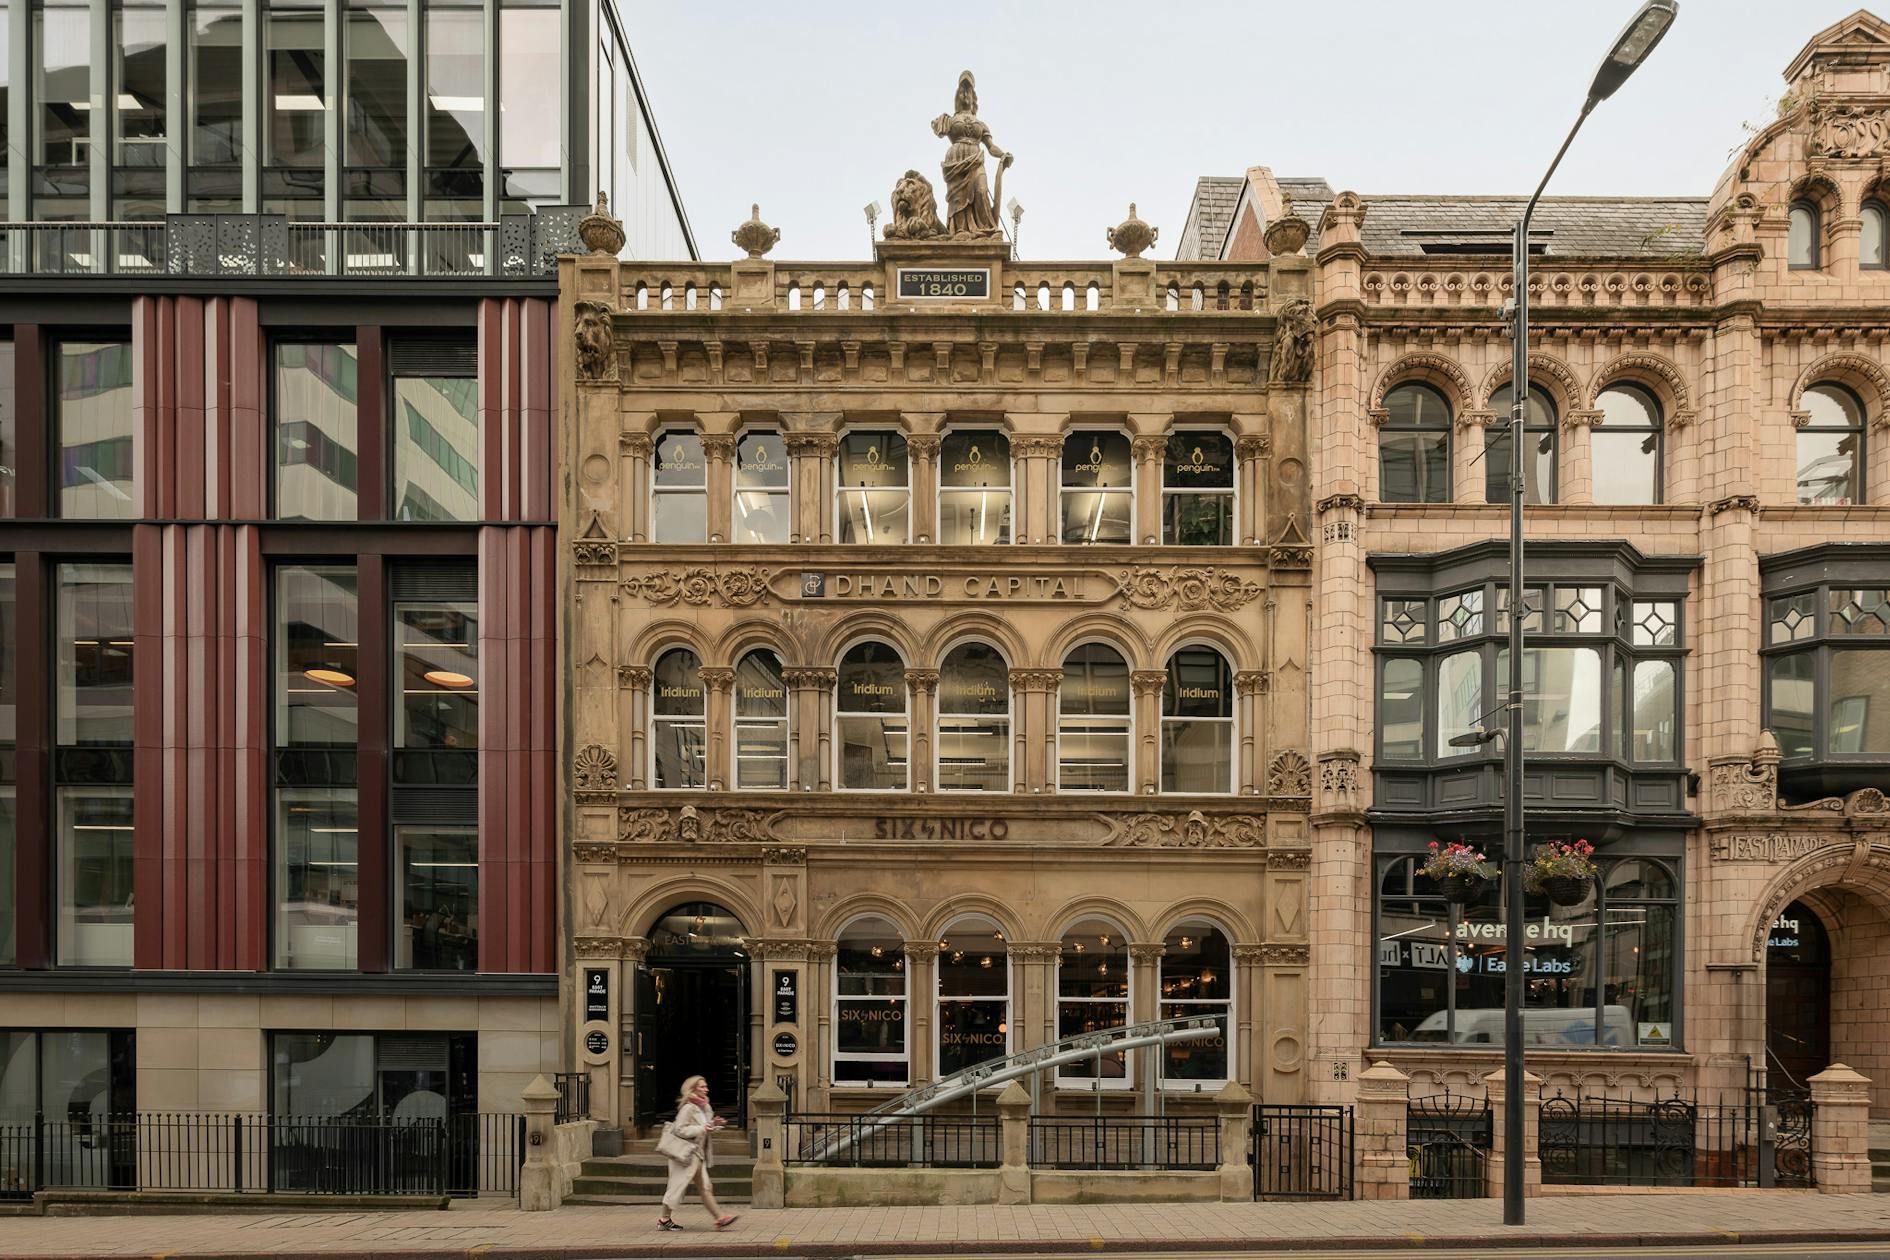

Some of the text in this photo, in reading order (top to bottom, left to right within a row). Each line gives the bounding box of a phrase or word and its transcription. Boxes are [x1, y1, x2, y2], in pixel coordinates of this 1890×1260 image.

[904, 274, 983, 282] ESTABLISHED
[920, 283, 967, 296] 1840
[660, 462, 695, 471] penguin
[742, 462, 777, 472] penguin
[852, 463, 889, 472] penguin
[1177, 463, 1214, 473] penguin
[835, 575, 1086, 598] DHAND CAPITAL
[661, 687, 700, 697] Iridium
[743, 687, 783, 698] Iridium
[854, 683, 894, 695] Iridium
[1179, 687, 1219, 698] Iridium
[874, 817, 916, 840] SIX
[940, 818, 1009, 840] NICO
[1735, 836, 1769, 859] EAST
[1780, 914, 1799, 934] hq
[1456, 915, 1573, 948] avene hq
[1775, 937, 1799, 947] Labs
[1487, 957, 1571, 973] Eae Labs
[593, 974, 602, 985] 9
[782, 976, 790, 987] 9
[841, 1009, 861, 1021] SIX
[868, 1009, 902, 1021] NICO
[942, 1033, 962, 1045] SIX
[970, 1033, 1003, 1045] NICO
[1190, 1036, 1225, 1048] NICO
